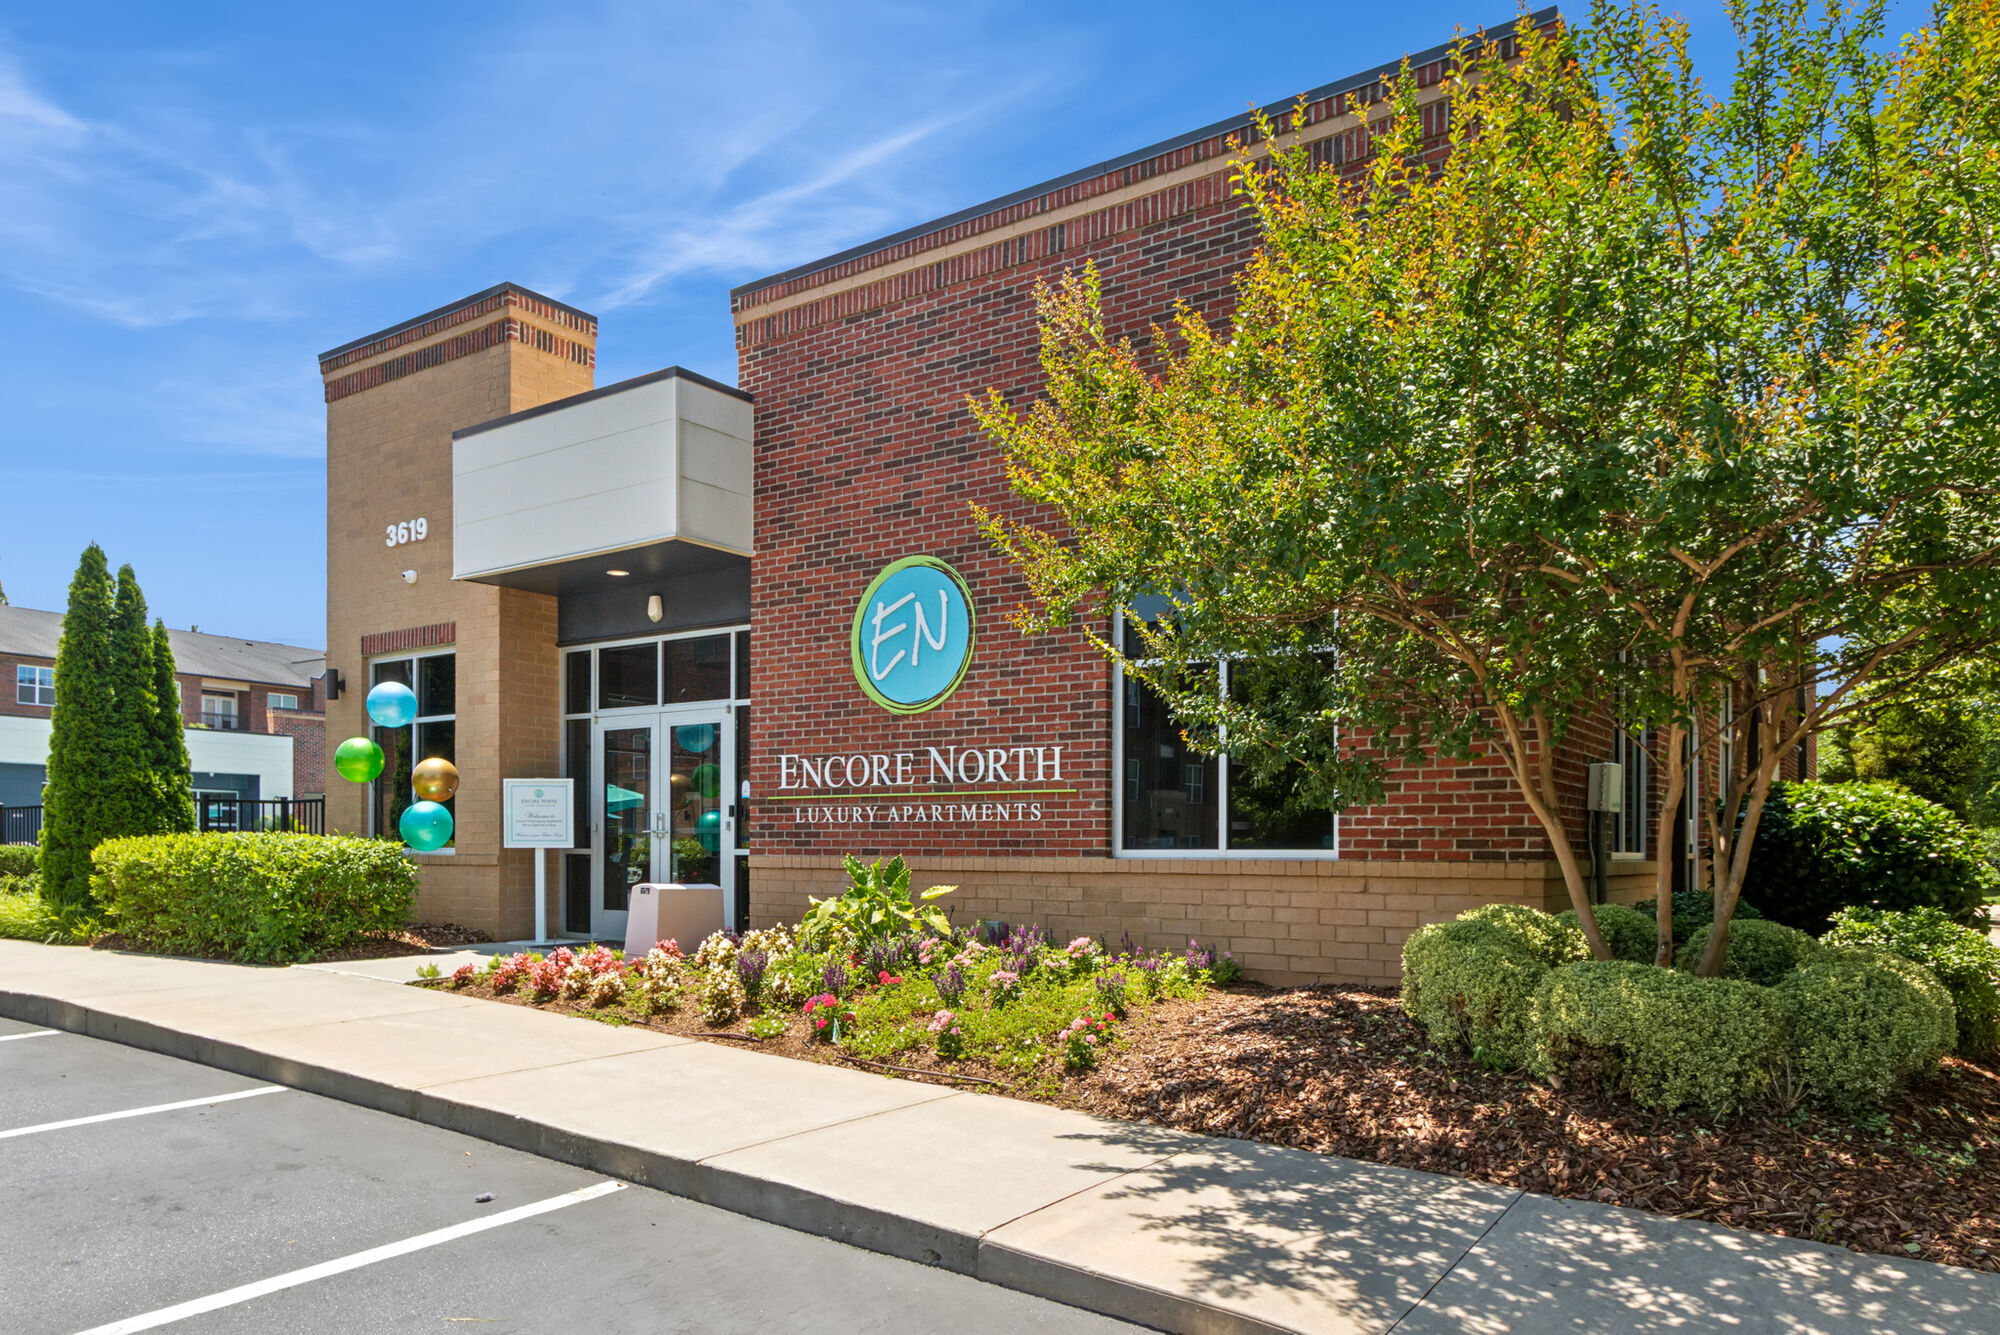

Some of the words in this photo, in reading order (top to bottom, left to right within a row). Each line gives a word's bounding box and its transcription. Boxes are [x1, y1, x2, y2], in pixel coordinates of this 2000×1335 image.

[385, 517, 428, 547] 3619
[872, 589, 948, 681] EN
[778, 753, 914, 790] ENCORE
[925, 746, 1064, 784] NORTH
[795, 806, 878, 823] LUXURY
[887, 803, 1042, 822] APARTMENTS
